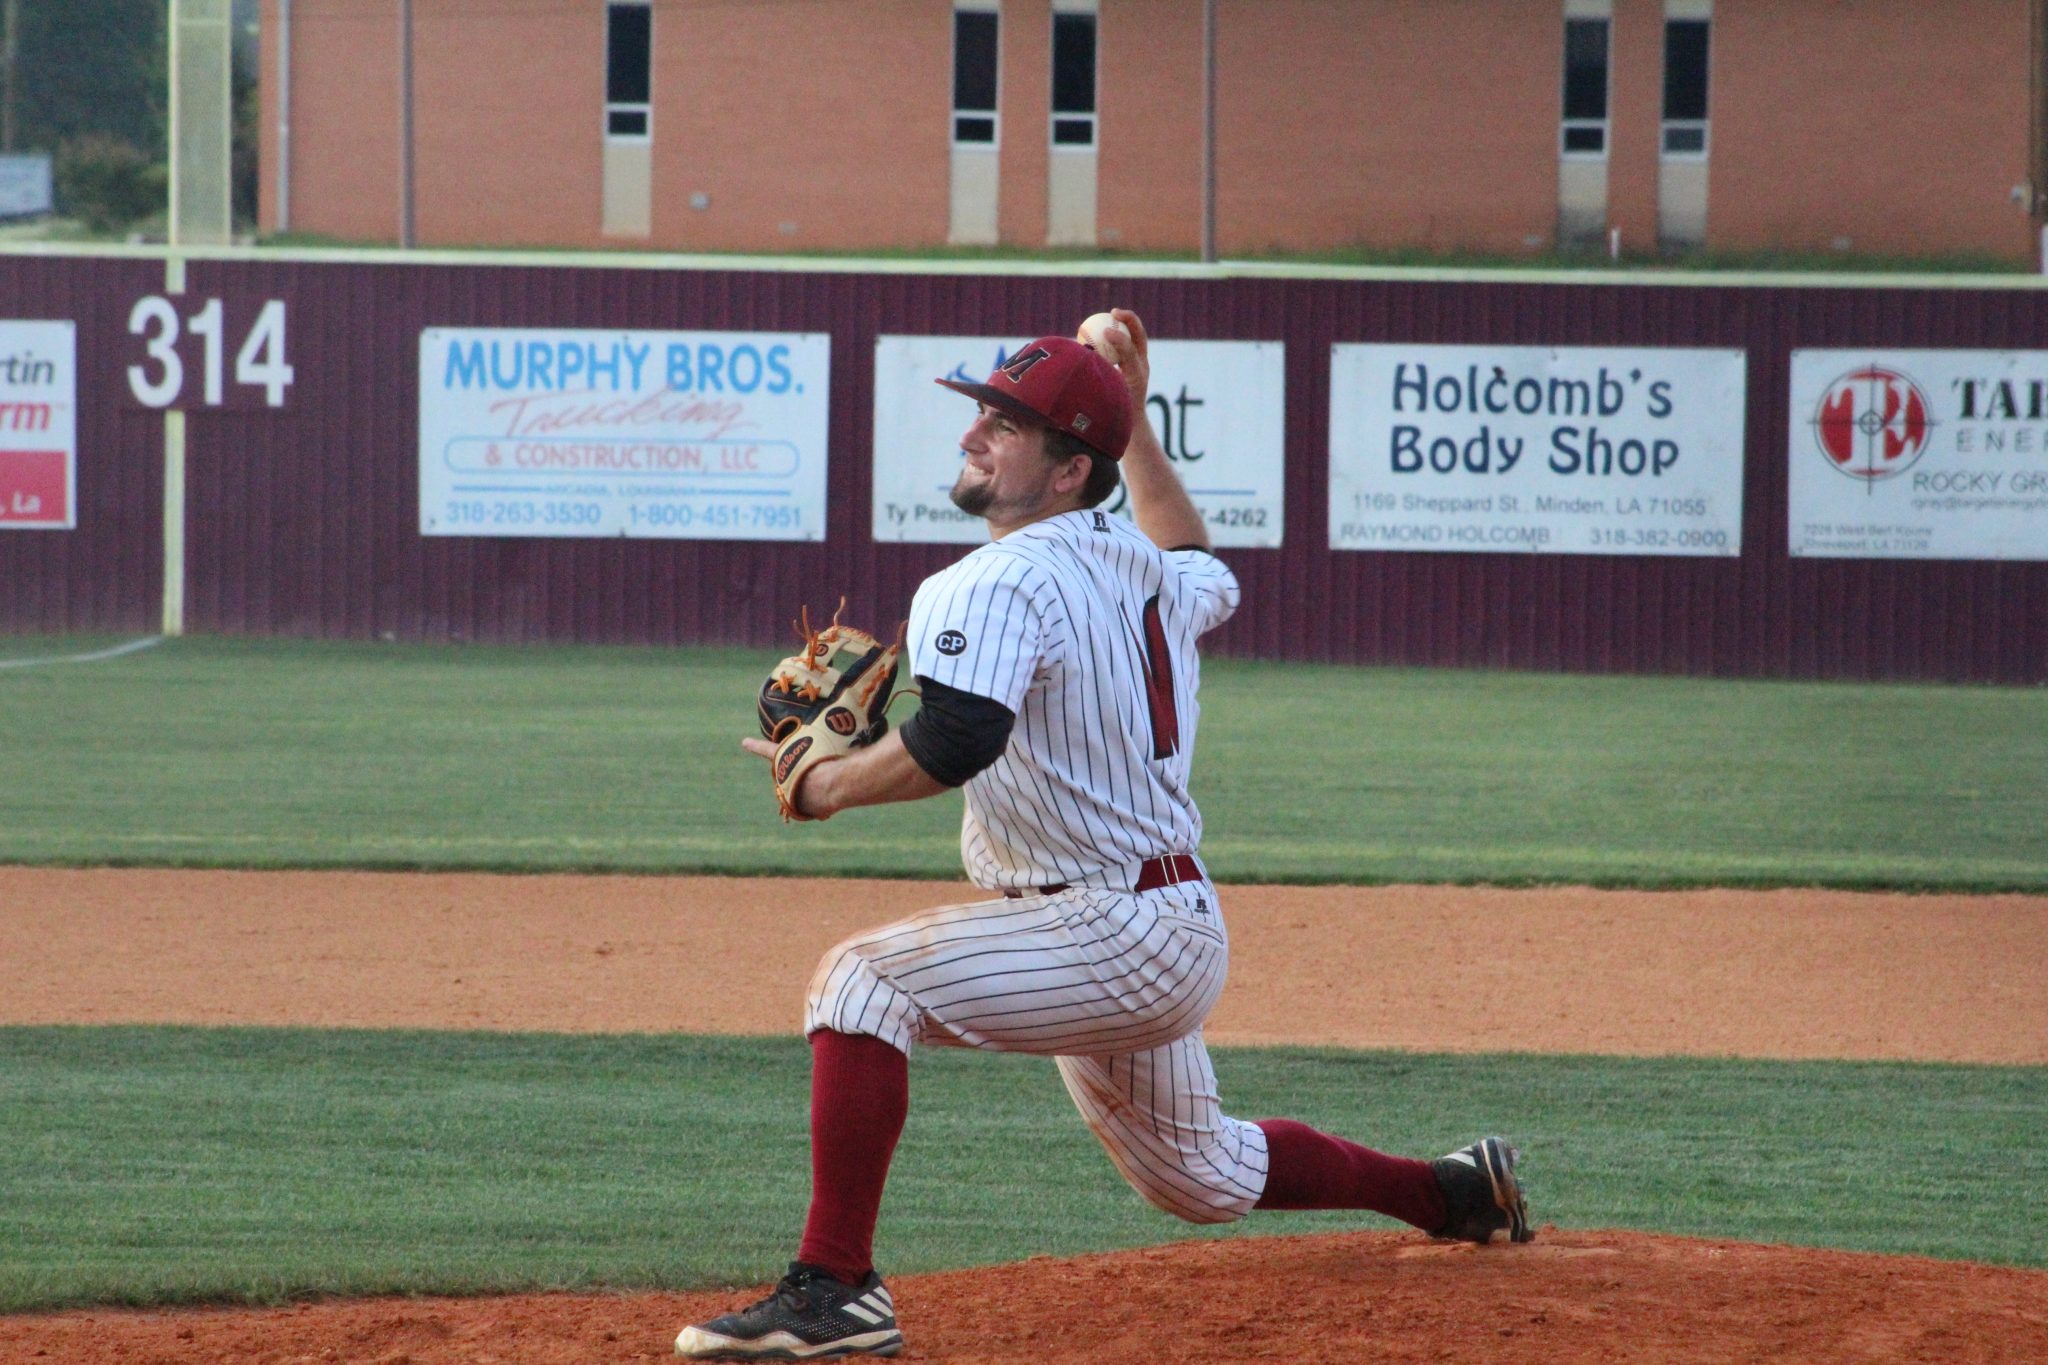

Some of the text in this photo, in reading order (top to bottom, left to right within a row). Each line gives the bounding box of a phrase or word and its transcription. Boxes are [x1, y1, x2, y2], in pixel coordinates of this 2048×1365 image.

[127, 295, 295, 408] 314
[994, 342, 1051, 384] M
[445, 339, 804, 395] MURPHY BROS.
[1391, 362, 1674, 418] Holcomb's
[489, 382, 760, 441] Trucking
[484, 444, 503, 466] &
[720, 447, 760, 471] LLC
[1389, 426, 1680, 477] Body Shop
[1912, 470, 2003, 493] ROCKY
[12, 490, 41, 514] La
[447, 501, 802, 529] 318-263-3530 1-800-451-7951
[886, 503, 907, 526] Ty
[1402, 493, 1494, 514] Sheppard
[1616, 498, 1643, 516] LA
[1340, 523, 1728, 549] RAYMOND HOLCOMB 318-382-0900
[938, 634, 965, 652] CP
